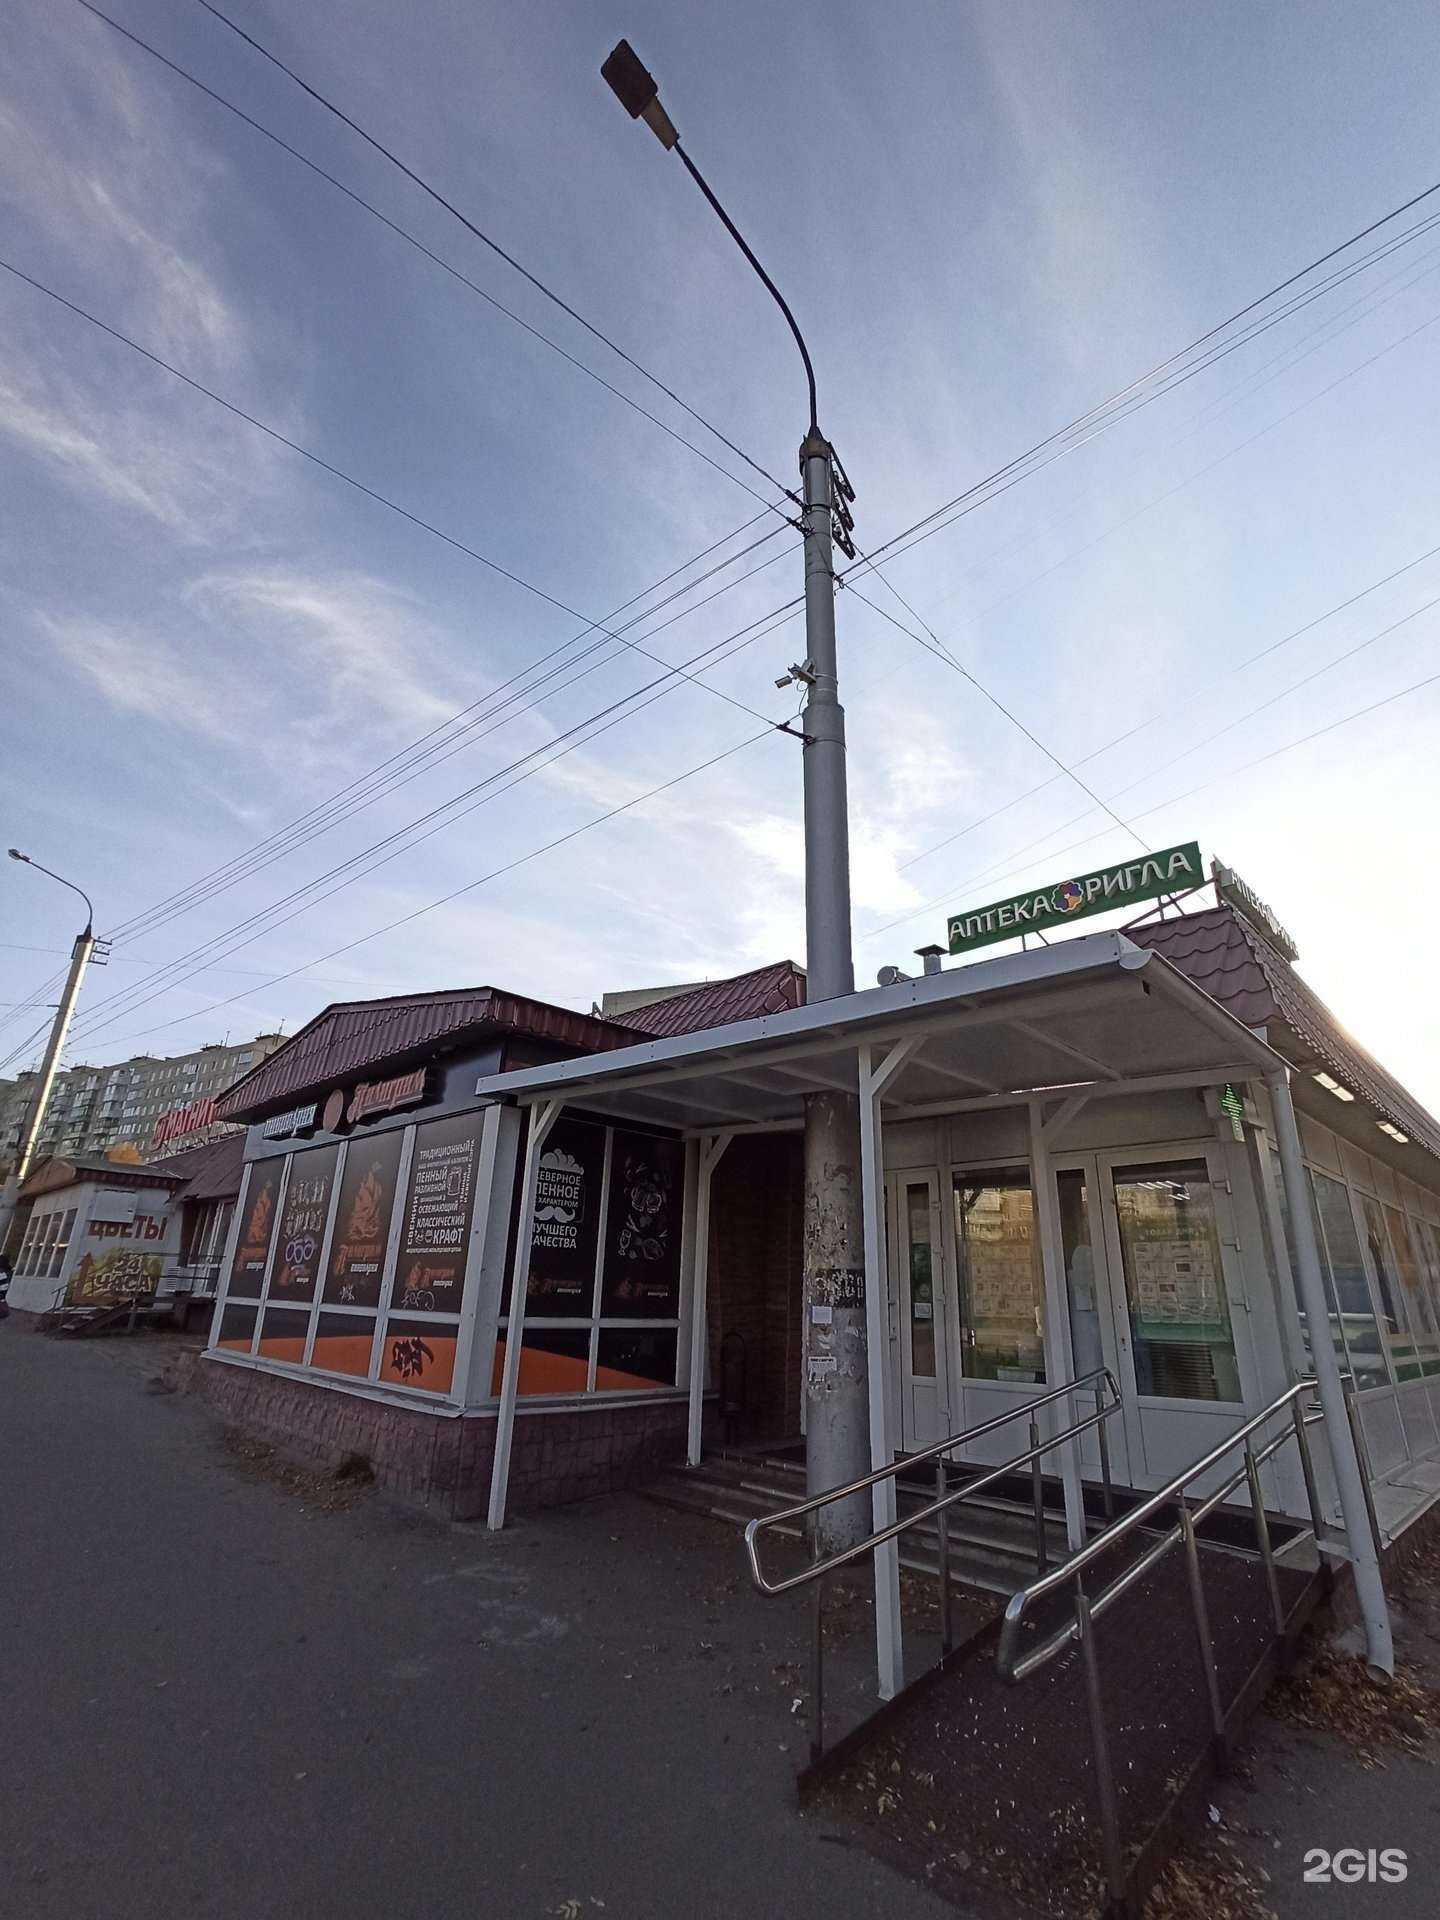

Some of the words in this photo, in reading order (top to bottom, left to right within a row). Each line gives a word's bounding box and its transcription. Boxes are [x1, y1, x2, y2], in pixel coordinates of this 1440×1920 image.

[949, 895, 1052, 941] АПТЕКА
[1085, 852, 1193, 901] РИГЛА
[419, 1140, 471, 1161] ТРАДИЦИОННЫЙ
[416, 1166, 448, 1184] ПЕННЫЙ
[414, 1181, 447, 1194] РАЗЛИВНОЙ
[418, 1200, 459, 1214] ОСВЕЖАЮЩИЙ
[87, 1215, 168, 1241] ЦВЕТЫ
[416, 1212, 466, 1228] КЛАССИЧЕСКИЙ
[432, 1228, 465, 1245] КРАФТ
[532, 1235, 577, 1249] АЧЕСТВА
